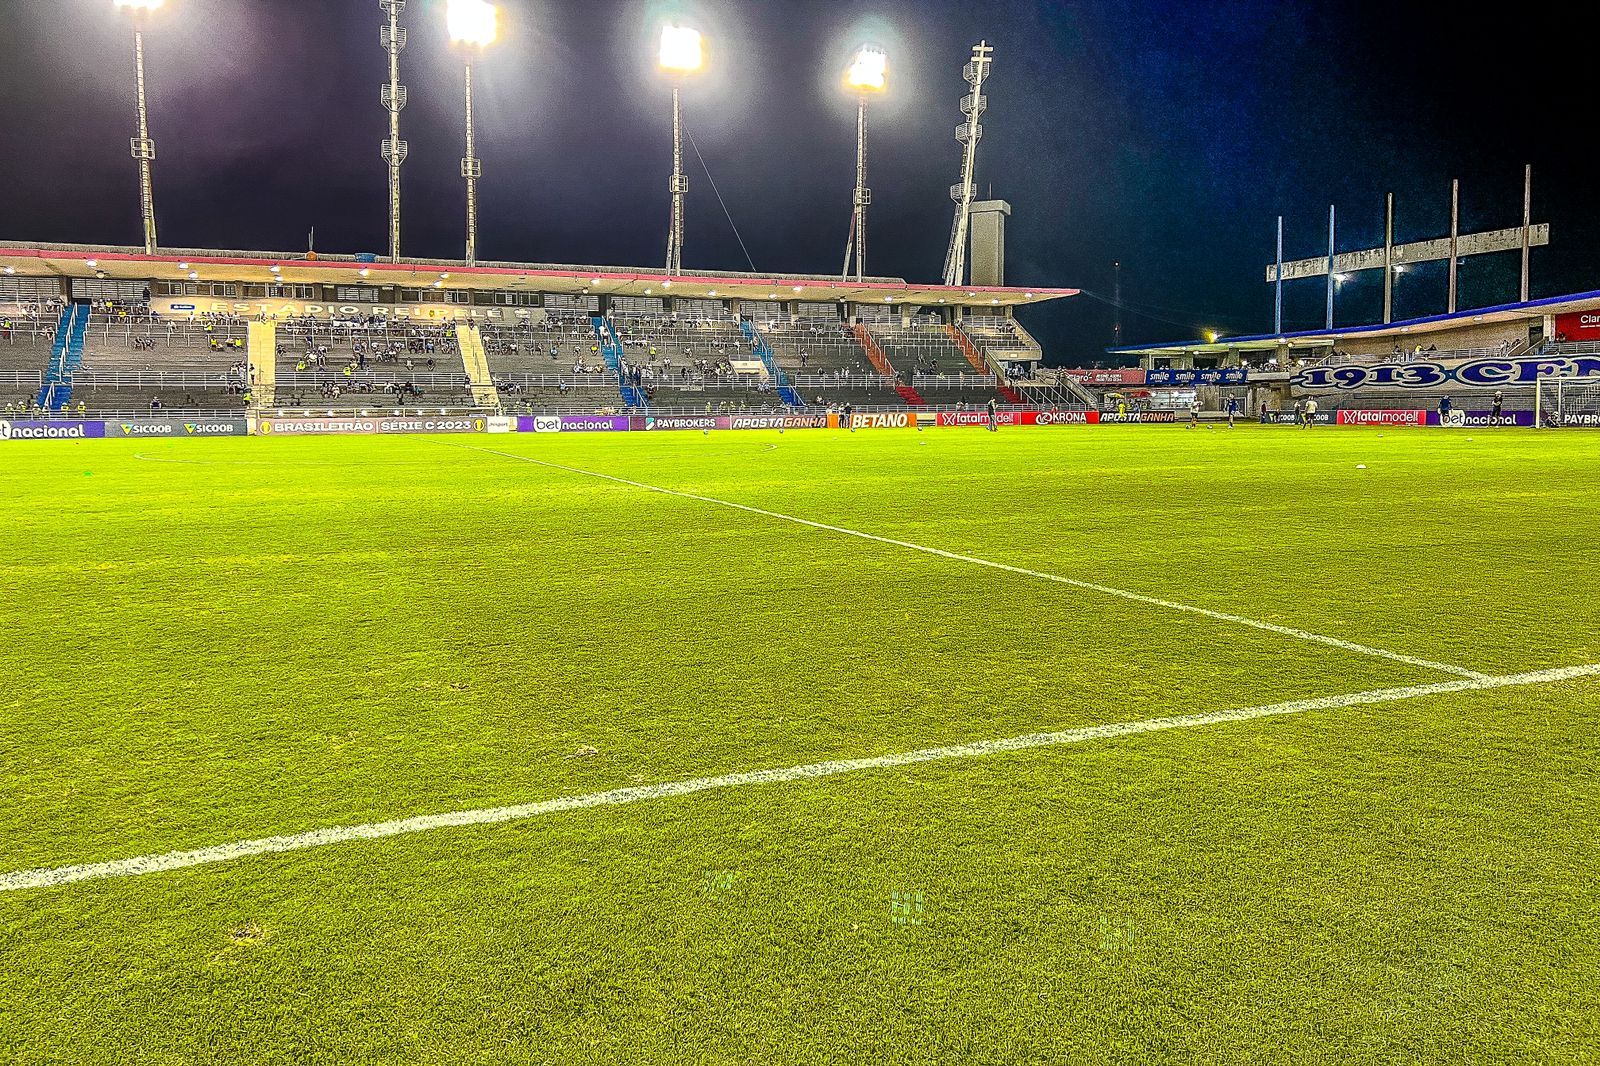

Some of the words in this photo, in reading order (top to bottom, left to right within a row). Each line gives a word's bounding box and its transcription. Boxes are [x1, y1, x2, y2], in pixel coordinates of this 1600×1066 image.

[372, 306, 421, 316] REI
[1149, 371, 1170, 381] smile
[1175, 371, 1196, 381] smile
[1201, 371, 1222, 381] smile
[1225, 371, 1243, 380] smile
[1301, 363, 1446, 388] 1913
[852, 413, 908, 428] BETANO
[1053, 412, 1087, 422] KRONA
[1564, 414, 1600, 424] PAYBR
[195, 423, 234, 433] SICOOB
[274, 421, 374, 433] BRASILEIRÃO
[381, 420, 422, 431] SÉRIE
[437, 421, 472, 430] 2023
[656, 418, 716, 428] PAYBROKERS
[132, 425, 172, 434] SICOOB
